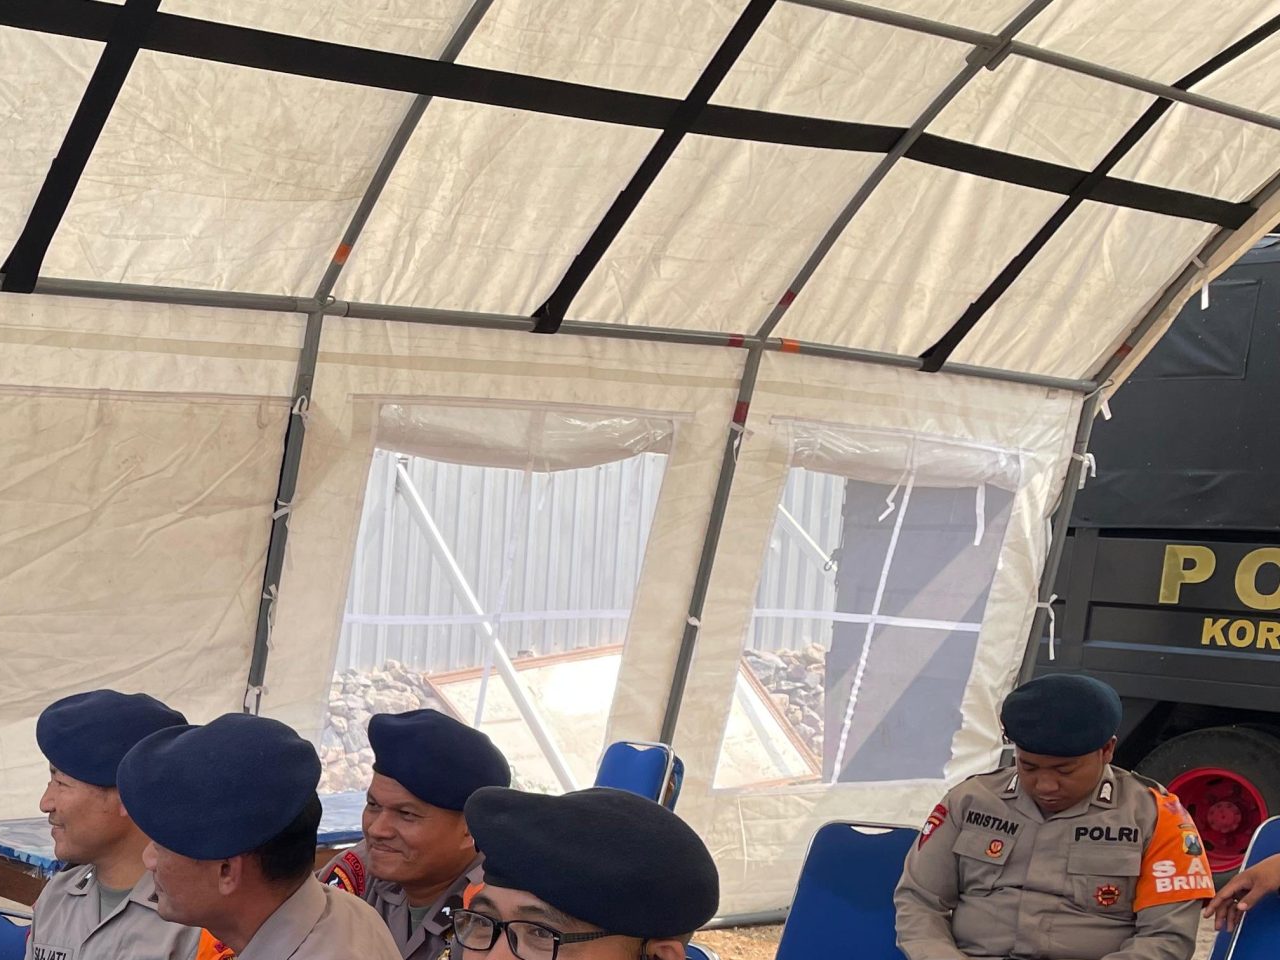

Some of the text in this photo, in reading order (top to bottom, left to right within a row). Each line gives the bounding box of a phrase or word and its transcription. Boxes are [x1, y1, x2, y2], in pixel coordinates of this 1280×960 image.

[1201, 618, 1280, 649] KOR
[966, 810, 1019, 835] KRISTIAN
[1075, 826, 1138, 843] POLRI
